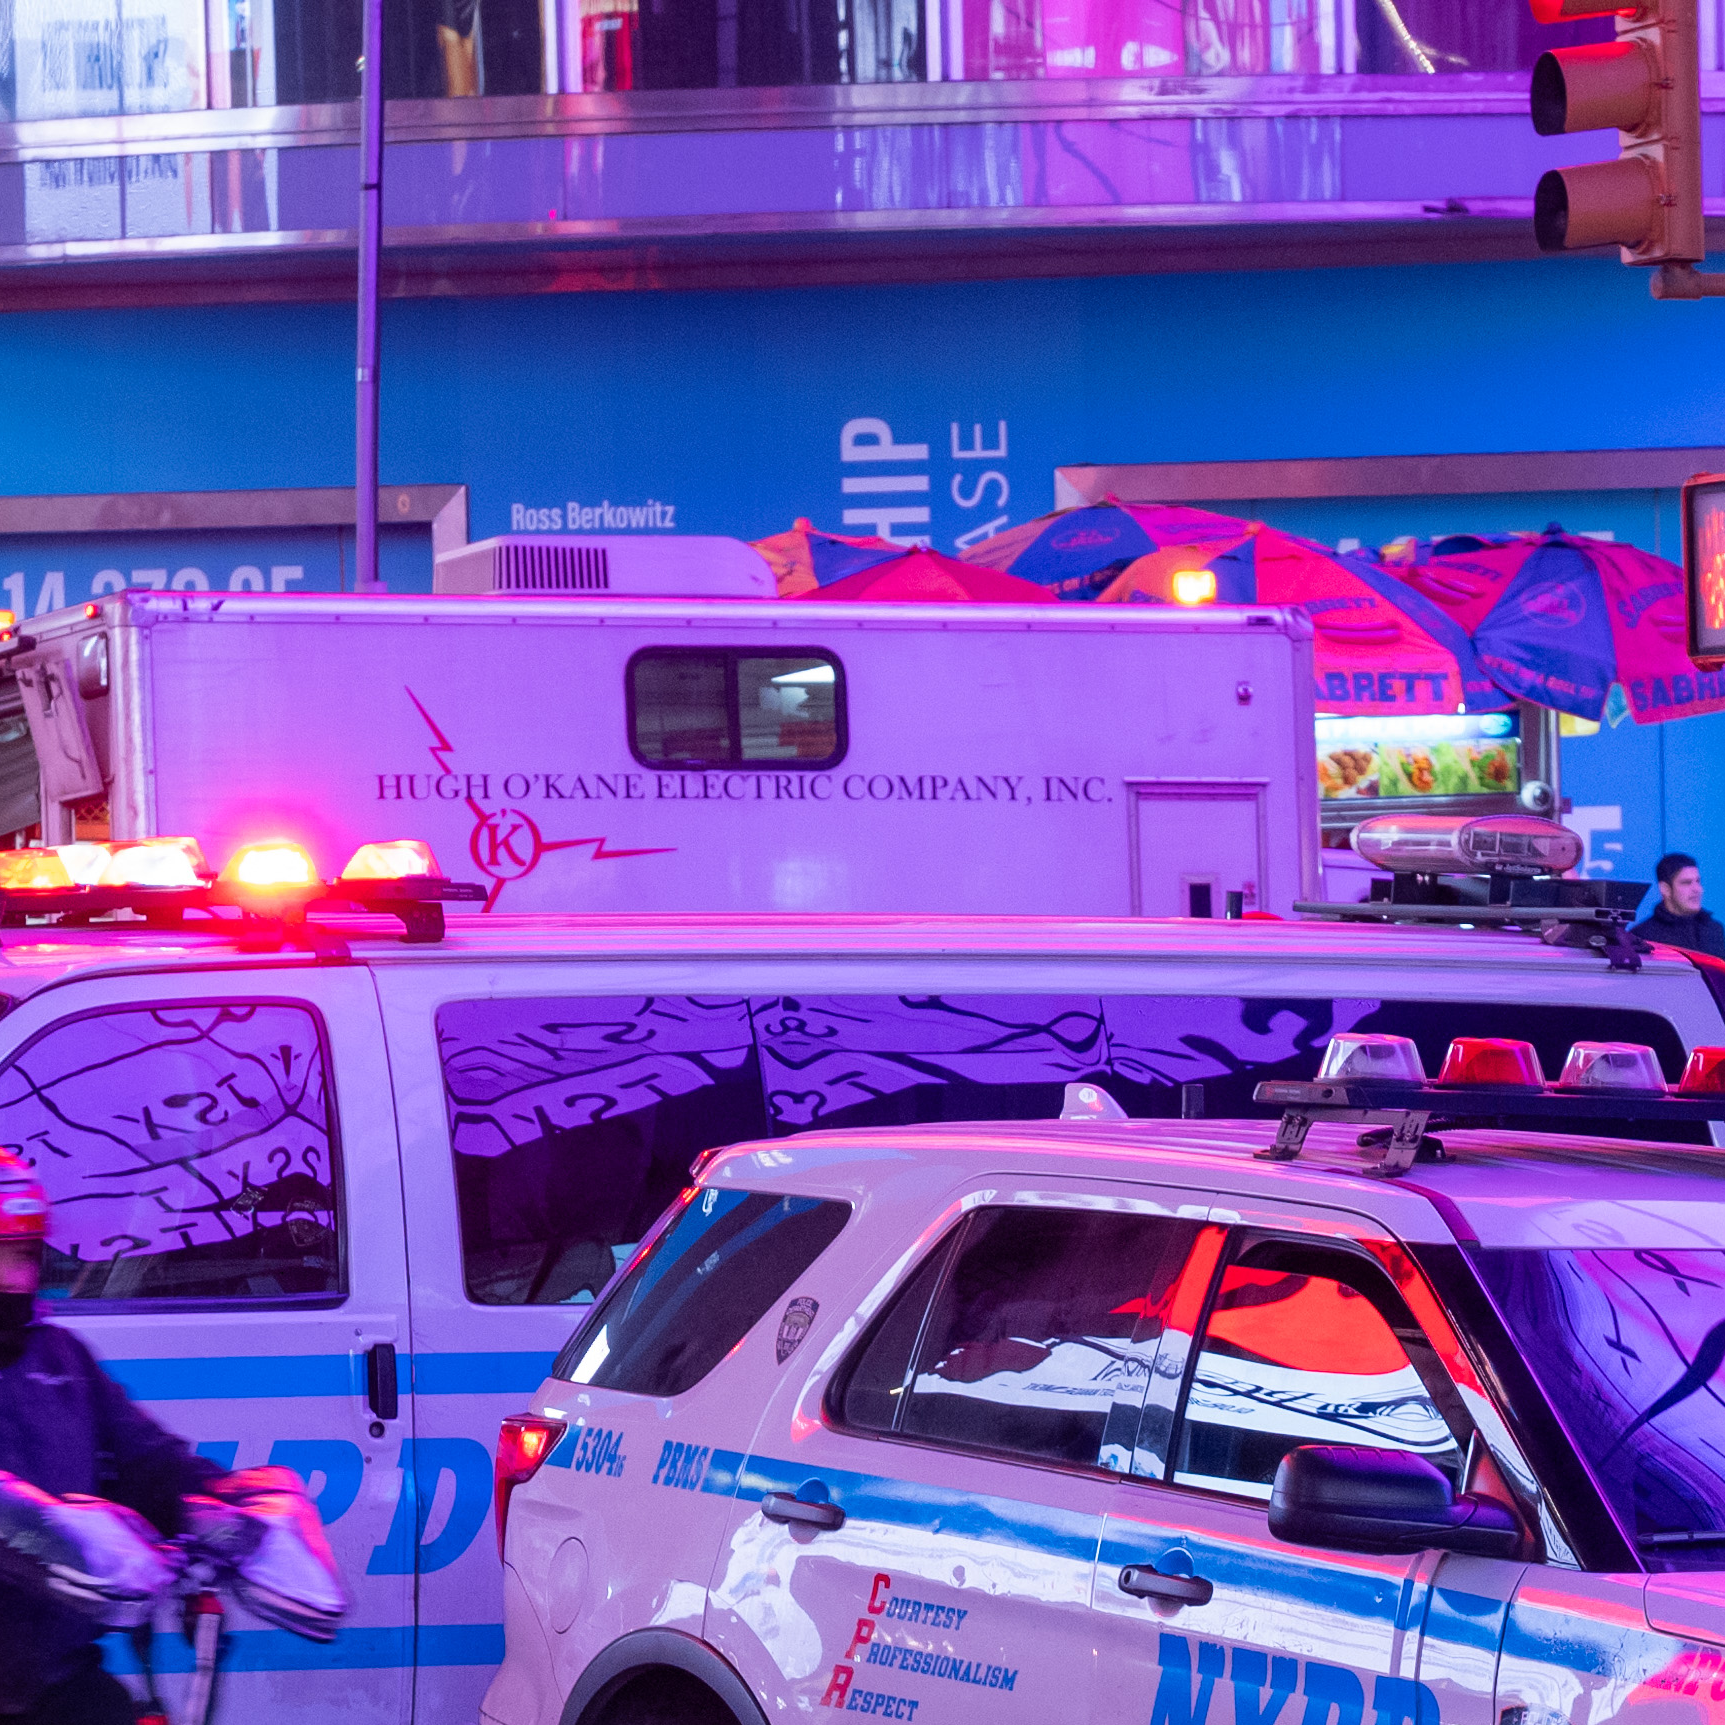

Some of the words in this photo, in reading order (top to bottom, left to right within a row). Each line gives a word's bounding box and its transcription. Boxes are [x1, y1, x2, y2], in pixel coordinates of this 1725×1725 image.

[510, 502, 562, 531] Ross
[566, 500, 676, 530] Berkowitz
[374, 774, 492, 801] HUGH
[502, 773, 646, 801] O'KANE
[655, 774, 833, 801] ELECTRIC
[842, 774, 1033, 807] COMPANY,
[1043, 776, 1115, 803] INC.
[575, 1426, 624, 1476] 5304
[867, 1572, 969, 1631] COURTESY
[843, 1617, 1020, 1692] PROFESSIONALISM
[819, 1663, 920, 1722] RESPECT
